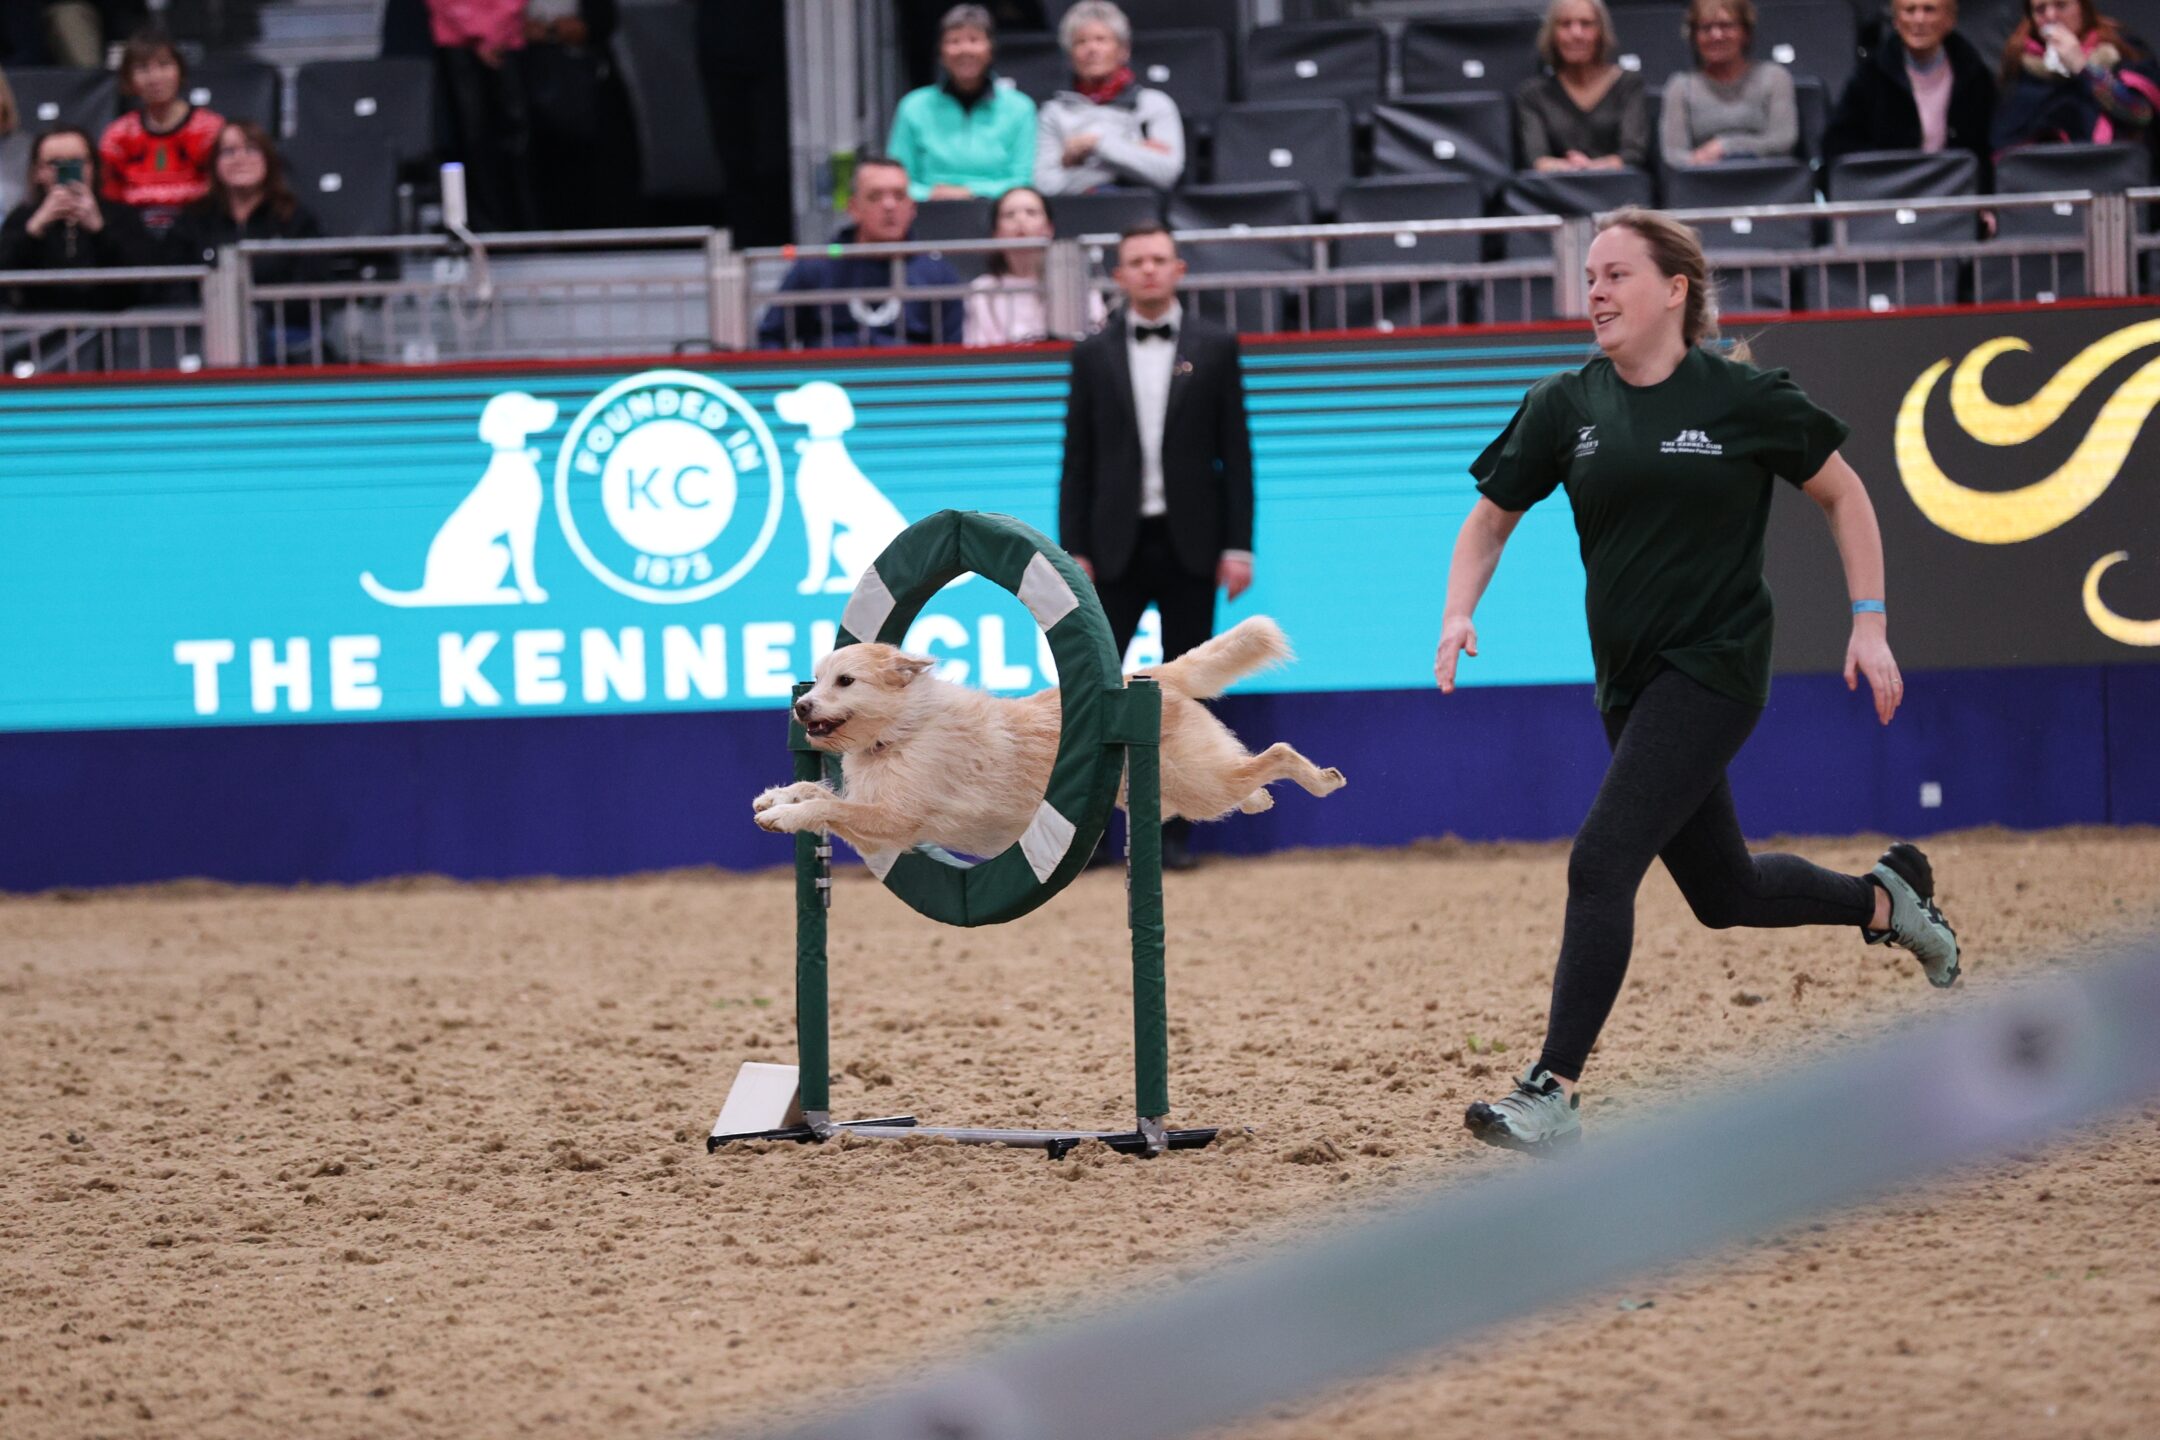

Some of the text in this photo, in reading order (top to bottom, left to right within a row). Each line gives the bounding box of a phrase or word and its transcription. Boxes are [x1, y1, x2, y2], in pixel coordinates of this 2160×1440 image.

[574, 388, 763, 475] FOUNDED IN
[626, 465, 711, 510] KC
[173, 634, 383, 715] THE
